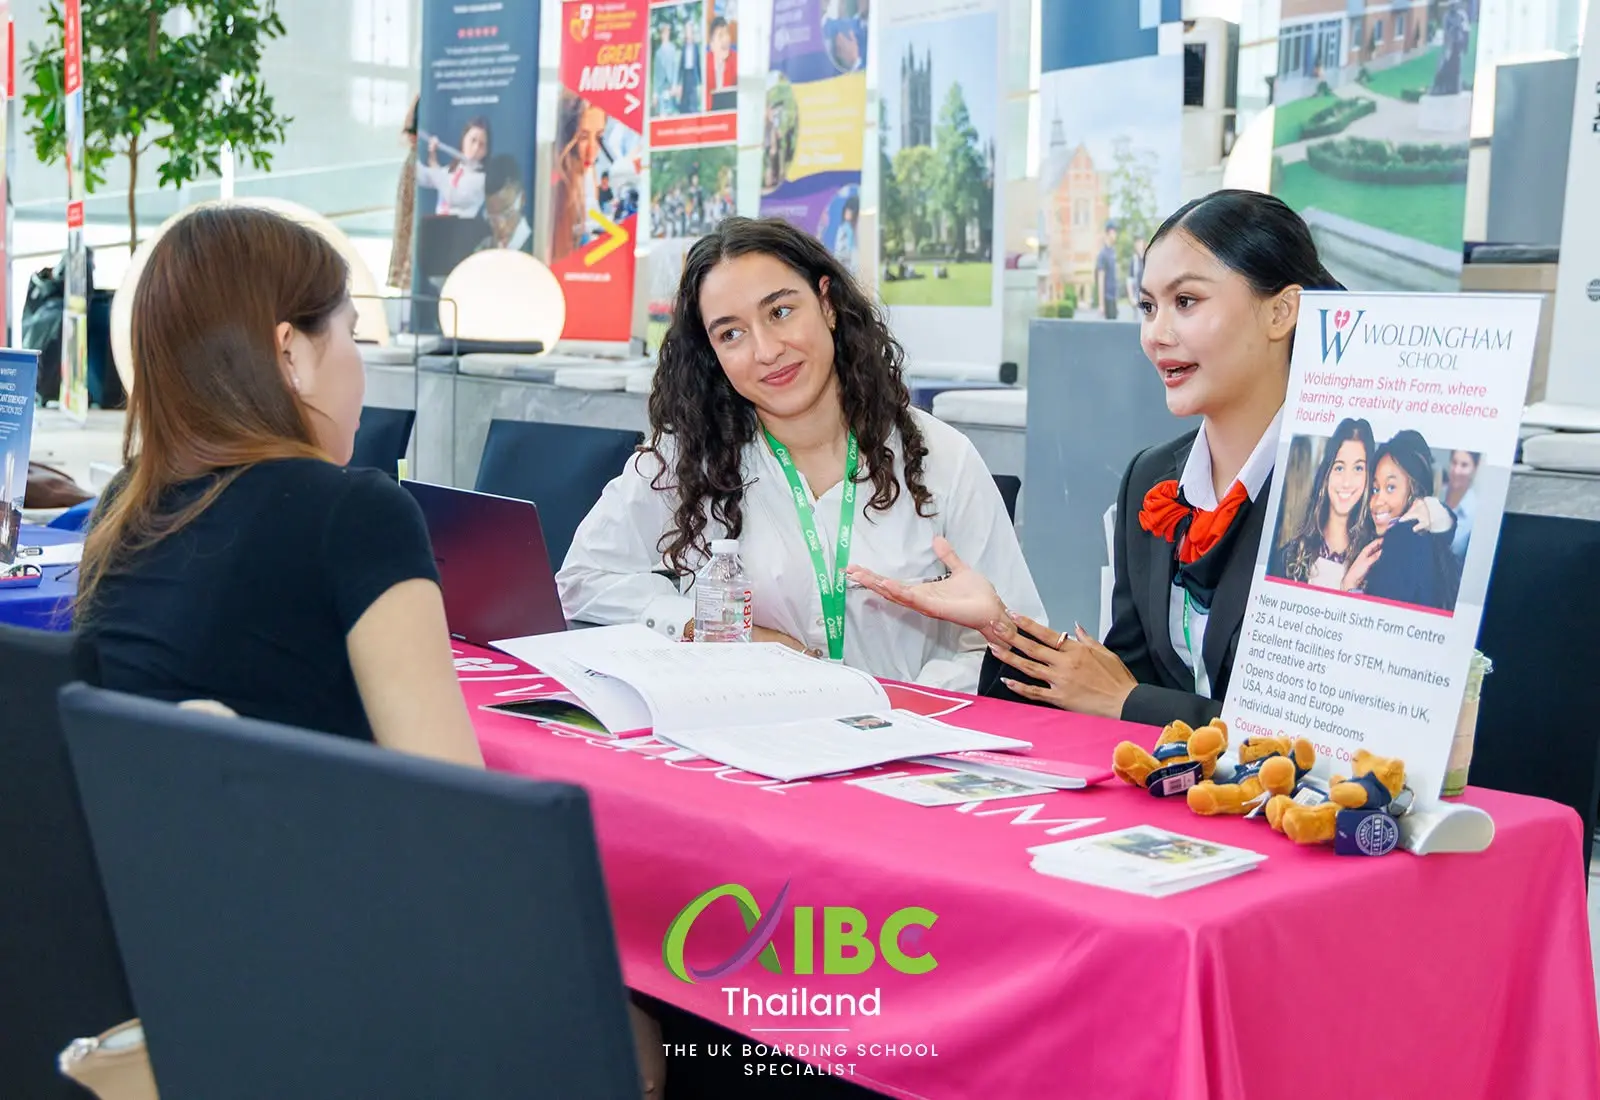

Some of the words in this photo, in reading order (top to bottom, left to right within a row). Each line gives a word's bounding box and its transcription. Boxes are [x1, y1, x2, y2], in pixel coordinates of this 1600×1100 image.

[597, 43, 642, 64] GREAT
[579, 63, 642, 92] MINDS
[1363, 324, 1513, 351] WOLDINGHAM
[1398, 351, 1459, 371] SCHOOL
[1303, 371, 1374, 391] Woldingham
[1377, 377, 1406, 392] Sixth
[1409, 379, 1443, 396] Form,
[1448, 381, 1487, 398] where
[1296, 408, 1335, 424] flourish
[1299, 390, 1345, 408] learning,
[1348, 395, 1402, 412] creativity
[1405, 399, 1428, 413] and
[1431, 401, 1498, 419] excellence
[1255, 612, 1266, 624] 25
[1267, 615, 1275, 626] A
[1278, 617, 1303, 633] Level
[1304, 623, 1343, 642] choices
[1258, 594, 1278, 610] New
[1279, 598, 1347, 624] purpose-built
[1349, 613, 1374, 629] Sixth
[1377, 618, 1404, 636] Form
[1406, 624, 1446, 645] Centre
[1248, 647, 1265, 660] and
[1267, 650, 1305, 670] creative
[1307, 660, 1326, 674] arts
[1252, 630, 1292, 650] Excellent
[1294, 640, 1335, 660] facilities
[1337, 648, 1351, 662] for
[1354, 653, 1385, 674] STEM,
[1387, 662, 1451, 688] humanities
[1242, 678, 1263, 695] USA,
[1265, 684, 1286, 701] Asia
[1288, 689, 1306, 705] and
[1309, 694, 1344, 716] Europe
[1245, 662, 1274, 681] Opens
[1276, 669, 1304, 687] doors
[1306, 677, 1317, 691] to
[1319, 679, 1336, 697] top
[1338, 684, 1395, 712] universities
[1397, 699, 1408, 715] in
[1410, 704, 1430, 723] UK,
[1238, 697, 1282, 718] Individual
[1284, 707, 1311, 729] study
[1313, 715, 1365, 742] bedrooms
[1373, 818, 1381, 851] ISLAND
